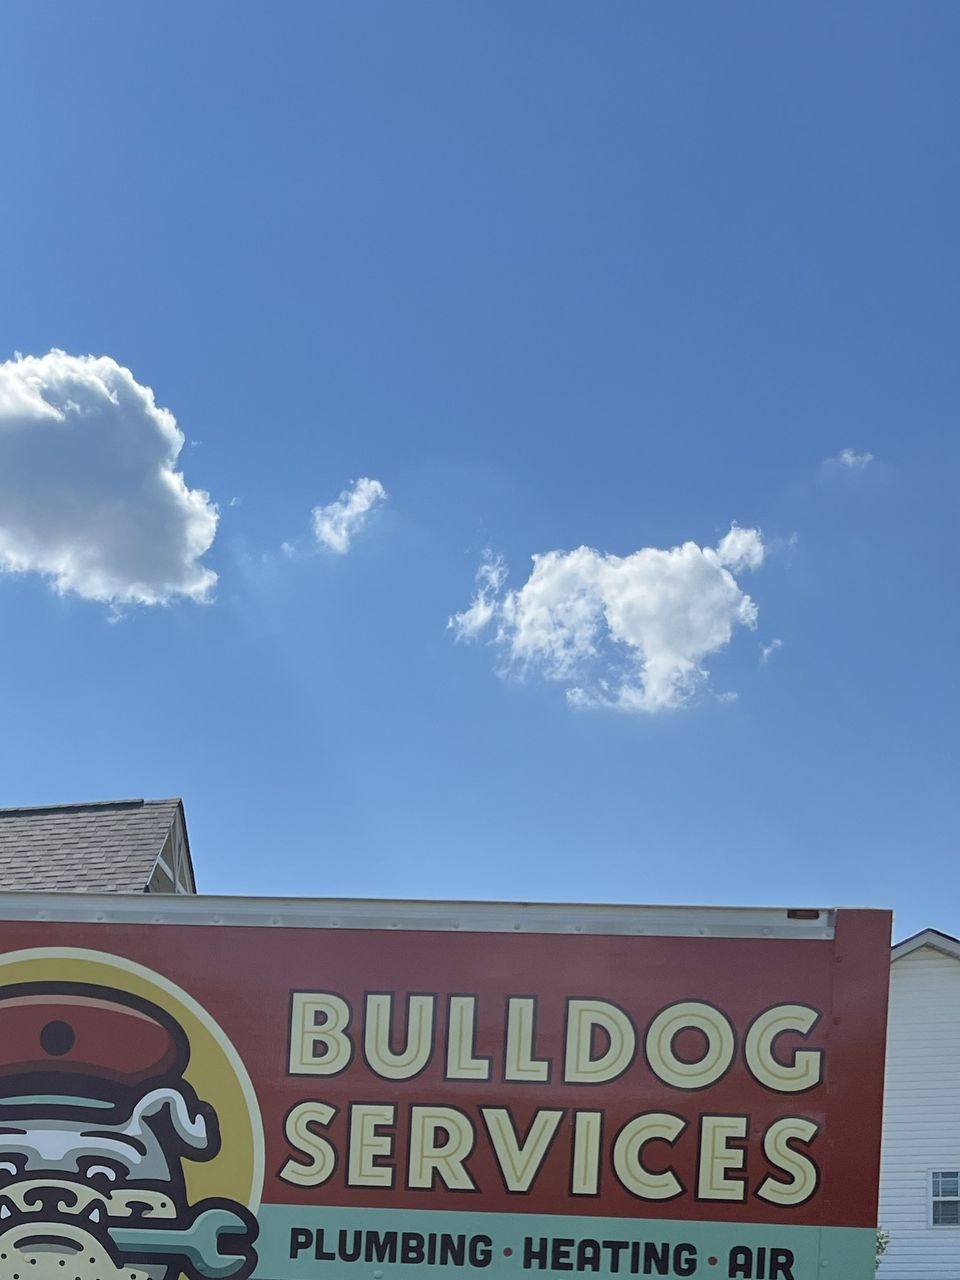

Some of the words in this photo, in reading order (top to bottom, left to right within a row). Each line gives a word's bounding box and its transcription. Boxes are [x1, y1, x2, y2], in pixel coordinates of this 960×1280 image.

[288, 990, 824, 1095] BULLDOG
[278, 1101, 820, 1206] SERVICES
[289, 1227, 493, 1268] PLUMBING
[523, 1236, 698, 1278] HEATING
